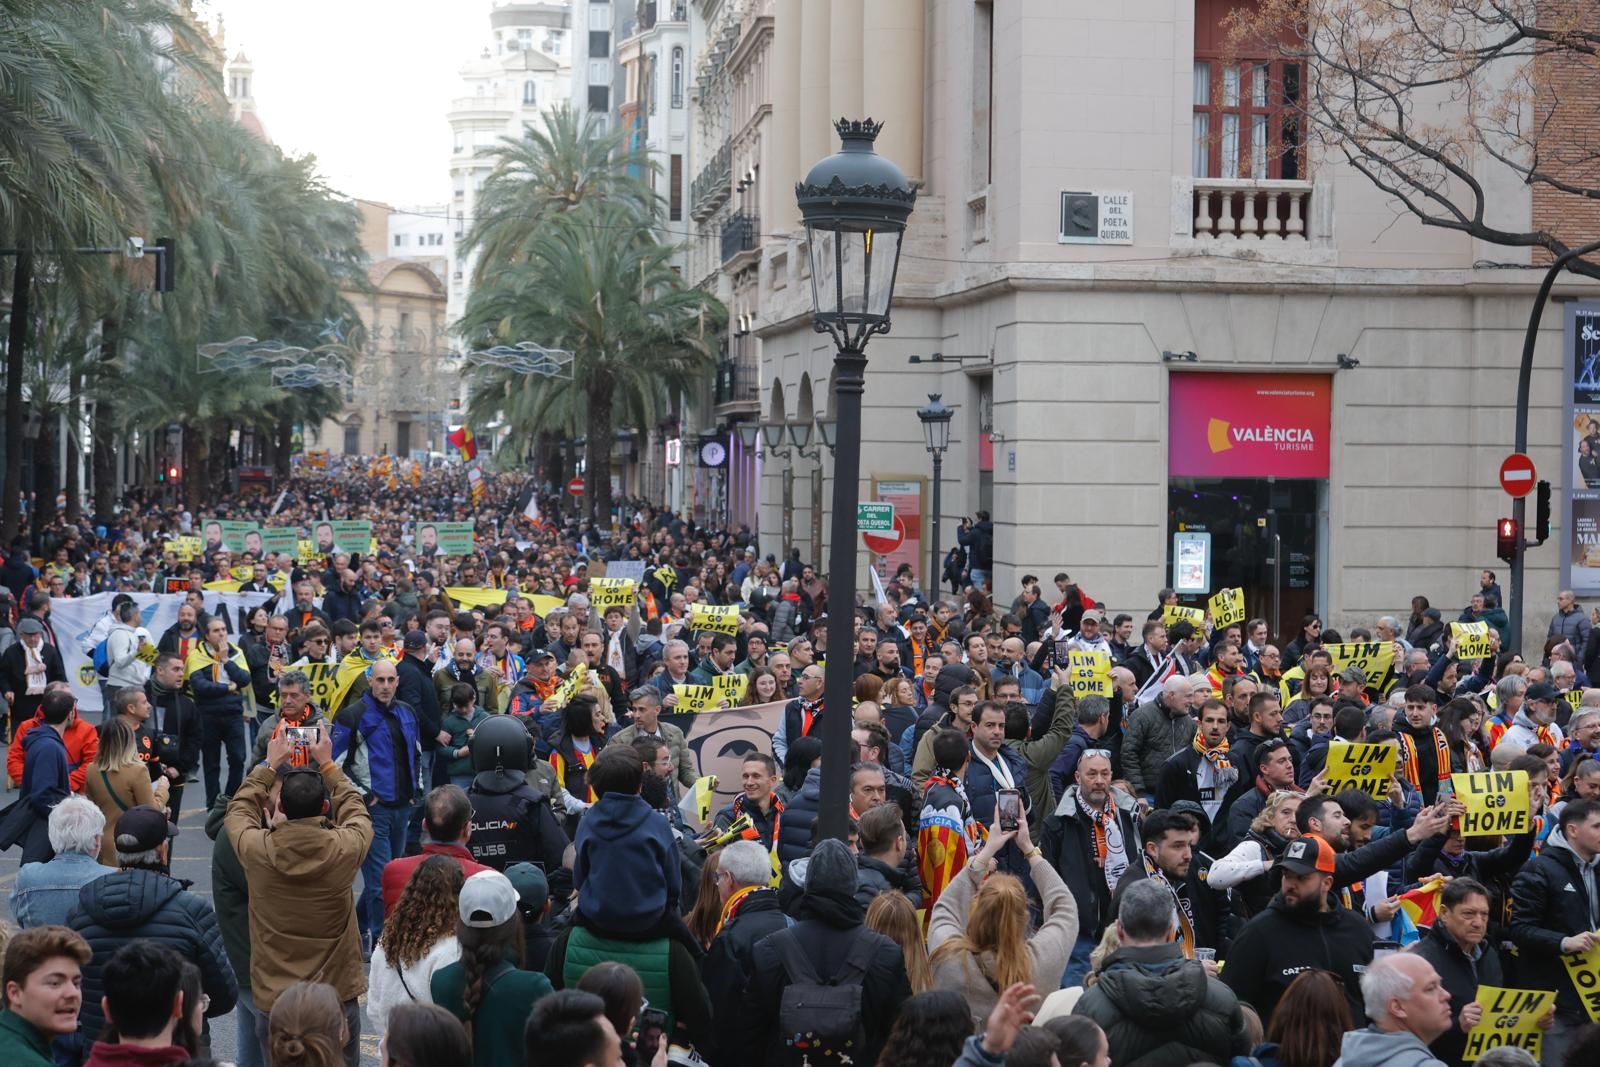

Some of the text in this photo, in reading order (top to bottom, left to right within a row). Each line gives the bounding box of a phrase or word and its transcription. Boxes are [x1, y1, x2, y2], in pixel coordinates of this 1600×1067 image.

[1103, 196, 1128, 205] CALLE
[1109, 207, 1123, 215] DEL
[1103, 218, 1128, 227] POETA
[1101, 230, 1130, 240] QUEROL
[1232, 425, 1314, 442] VALÈNCIA
[1274, 443, 1314, 451] TURISME
[600, 579, 625, 587] LIM
[593, 595, 633, 604] HOME
[1214, 590, 1237, 607] LIM
[701, 606, 729, 614] LIM
[1171, 607, 1196, 618] LIM
[1215, 608, 1244, 628] HOME
[691, 622, 737, 633] HOME
[1459, 623, 1482, 634] LIM
[1470, 634, 1480, 643] GO
[1339, 643, 1381, 659] LIM
[1459, 644, 1491, 656] HOME
[1073, 656, 1095, 666] LIM
[1079, 669, 1093, 677] GO
[719, 676, 741, 688] LIM
[1069, 681, 1104, 691] HOME
[685, 686, 714, 700] LIM
[725, 689, 736, 697] GO
[690, 700, 704, 708] GO
[1343, 744, 1391, 763] LIM
[1351, 765, 1372, 776] GO
[1322, 778, 1391, 796] HOME
[1469, 773, 1514, 794] LIM
[1485, 795, 1506, 808] GO
[470, 821, 509, 831] OLICIA
[1464, 811, 1526, 832] HOME
[1490, 991, 1545, 1013] LIM
[1495, 1015, 1519, 1028] GO
